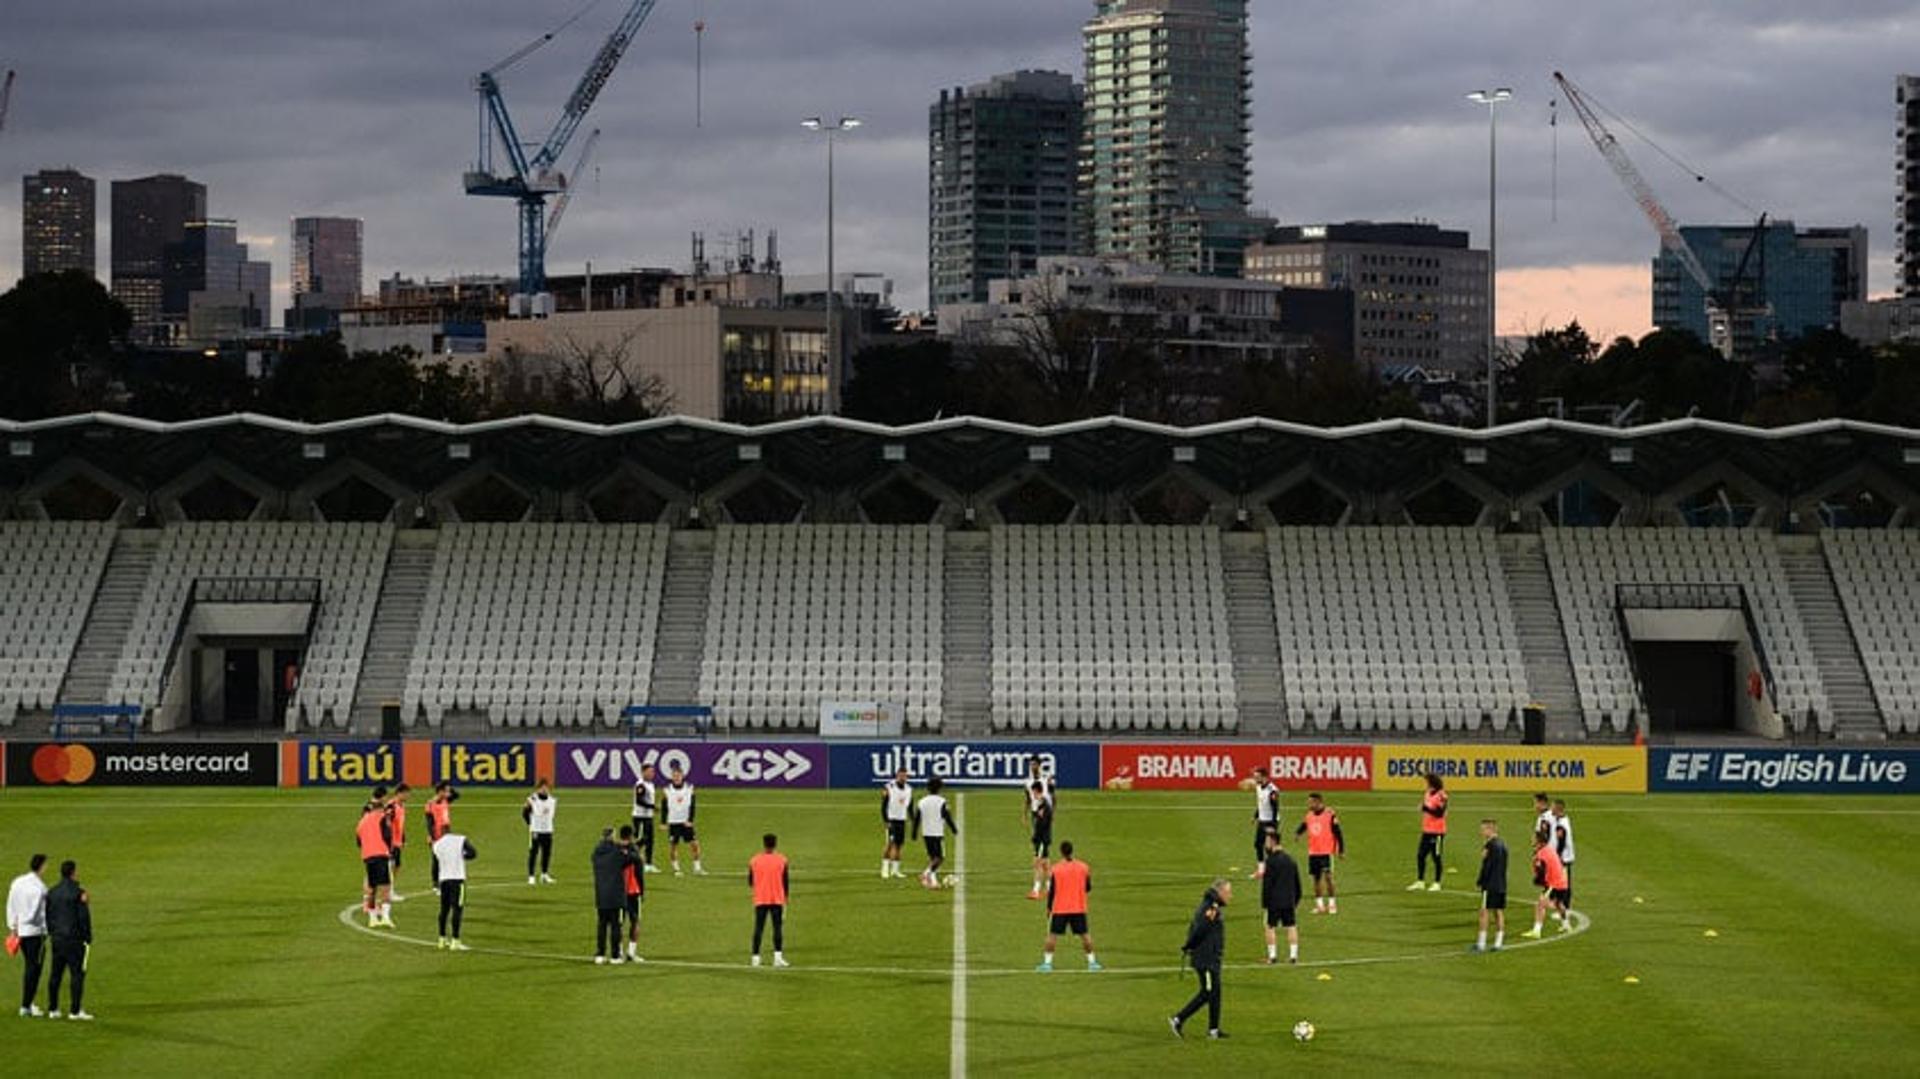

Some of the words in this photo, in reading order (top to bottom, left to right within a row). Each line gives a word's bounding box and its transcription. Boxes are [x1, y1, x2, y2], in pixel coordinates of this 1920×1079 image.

[106, 751, 250, 772] mastercard
[308, 744, 394, 781] Itaú
[440, 744, 527, 781] Itaú
[871, 745, 1056, 777] ultrafarma
[1137, 755, 1235, 779] BRAHMA
[1270, 755, 1368, 780] BRAHMA
[1387, 758, 1469, 778] DESCUBRA
[1474, 759, 1499, 778] EM
[1504, 759, 1585, 779] NIKE.COM
[1666, 753, 1712, 781] EF
[1719, 753, 1834, 788] English
[1837, 753, 1907, 782] Live
